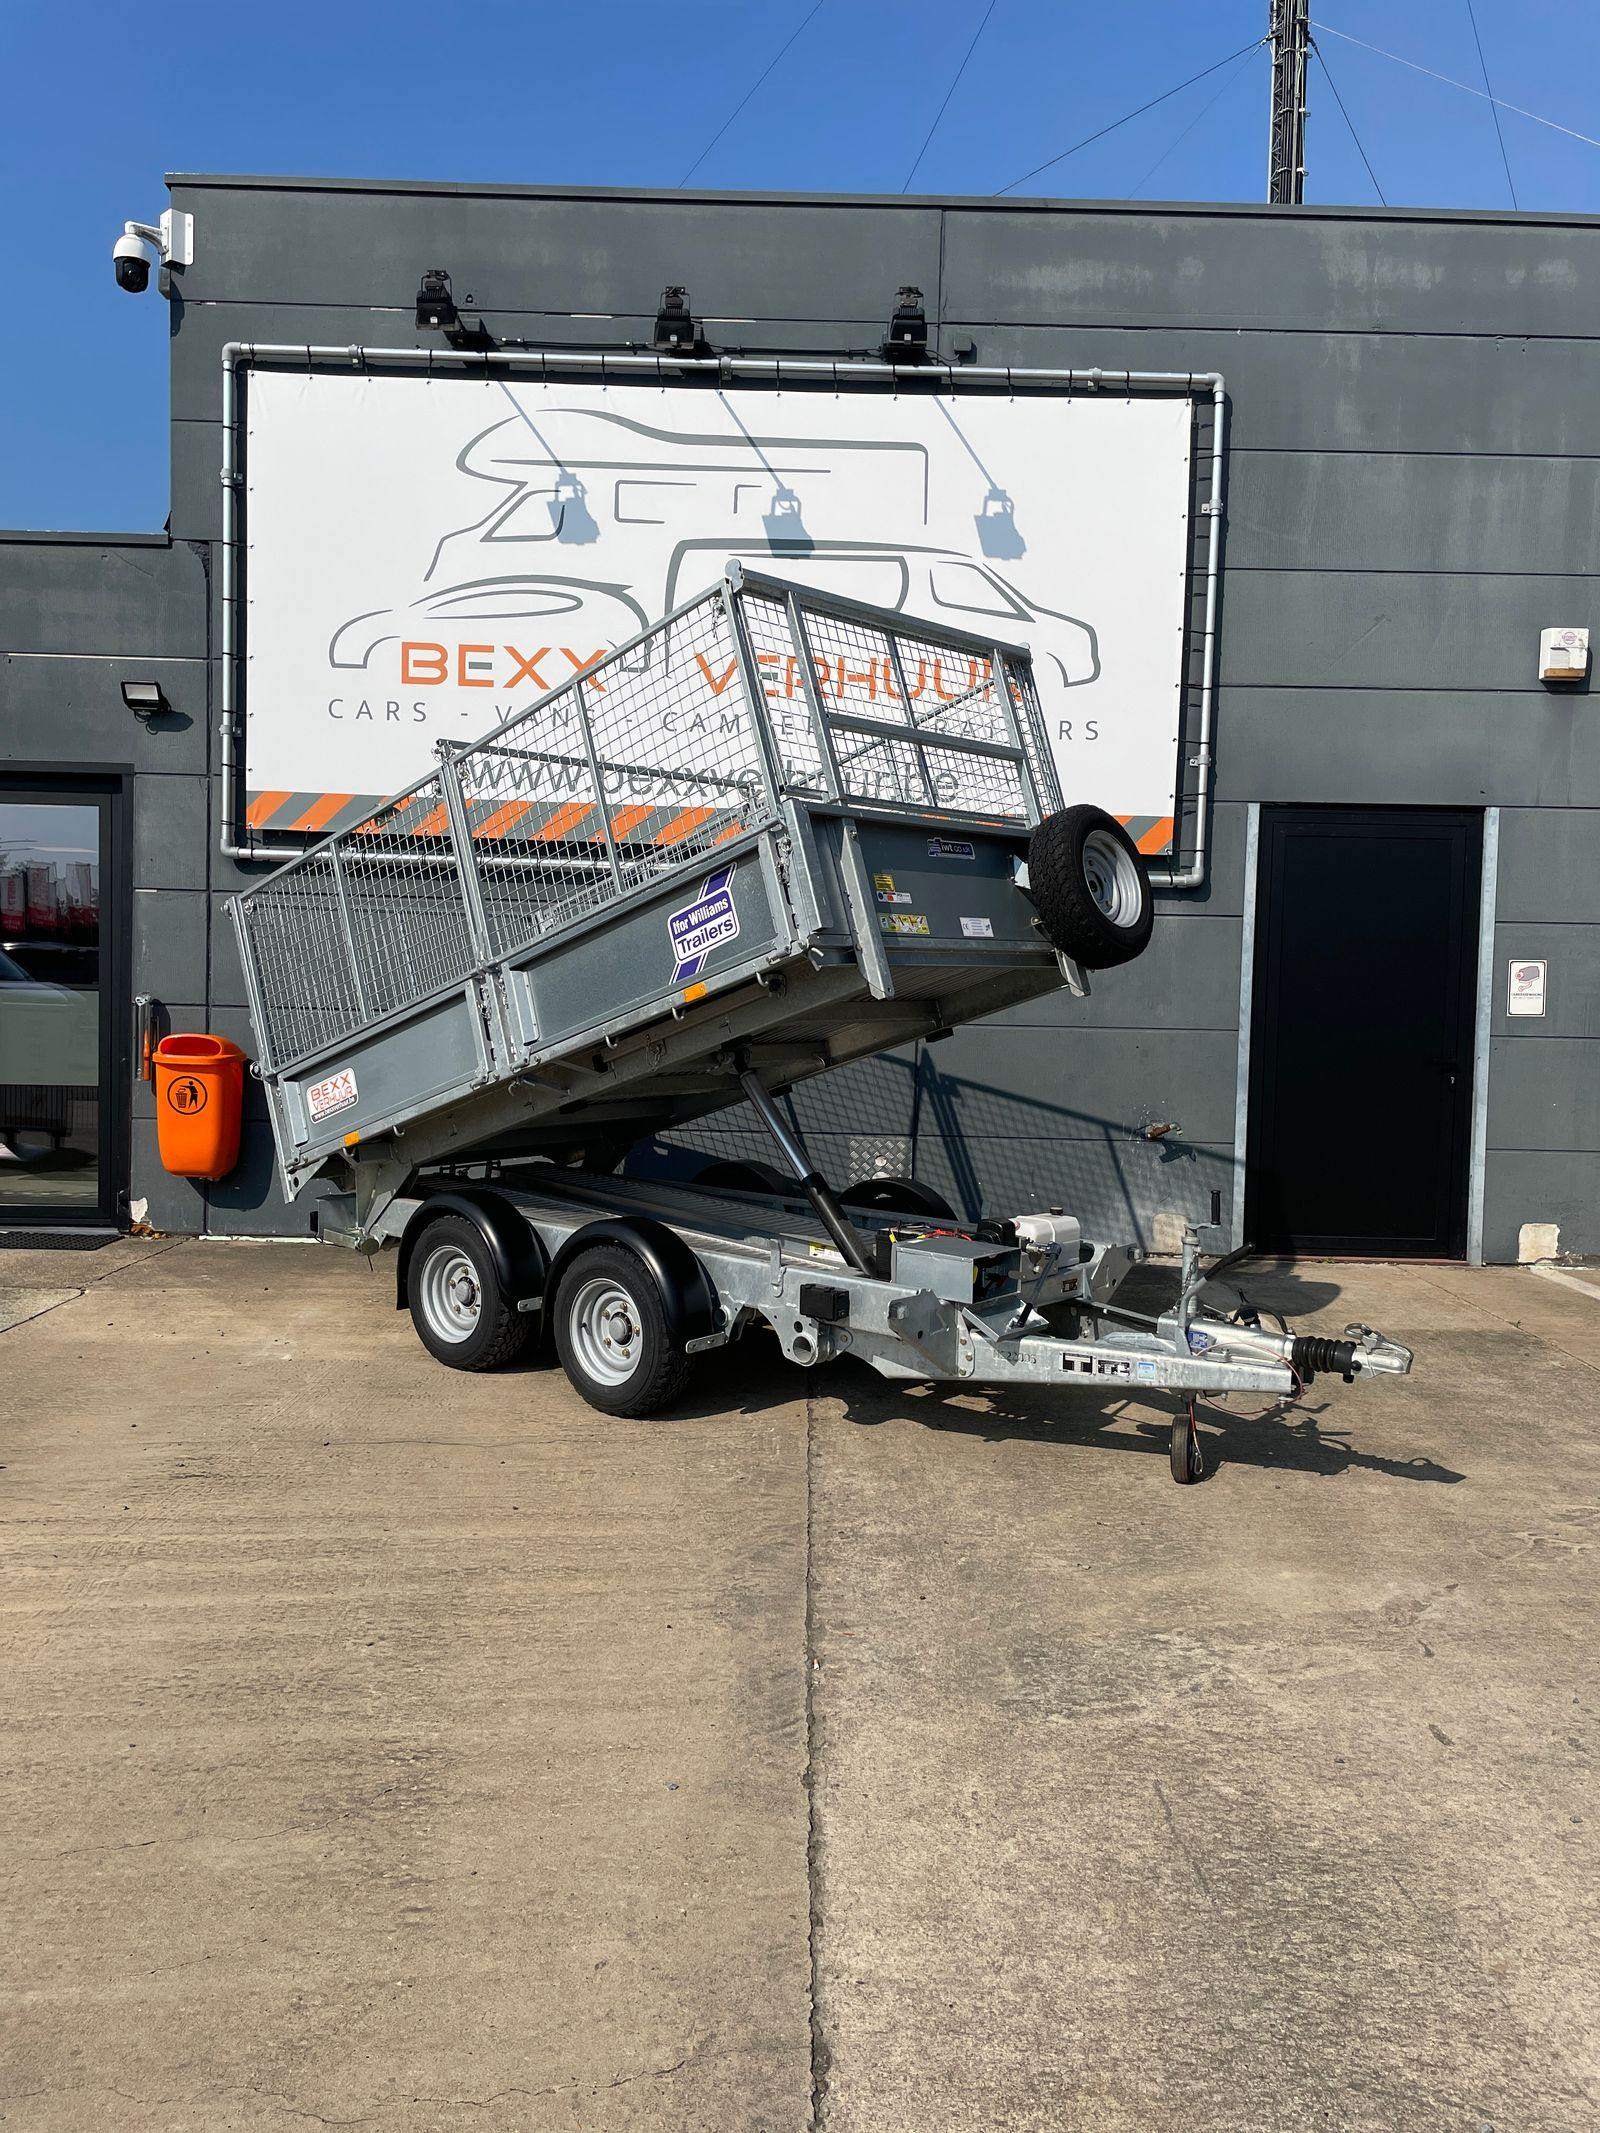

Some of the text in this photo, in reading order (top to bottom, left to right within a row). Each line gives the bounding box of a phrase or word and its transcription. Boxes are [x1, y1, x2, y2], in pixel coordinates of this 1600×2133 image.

[401, 640, 607, 693] BEXX
[328, 697, 427, 723] CARS
[672, 897, 729, 935] Ifor Williams
[678, 919, 734, 954] Trailers
[310, 1072, 351, 1102] BEXX
[313, 1085, 354, 1111] VERHUUR
